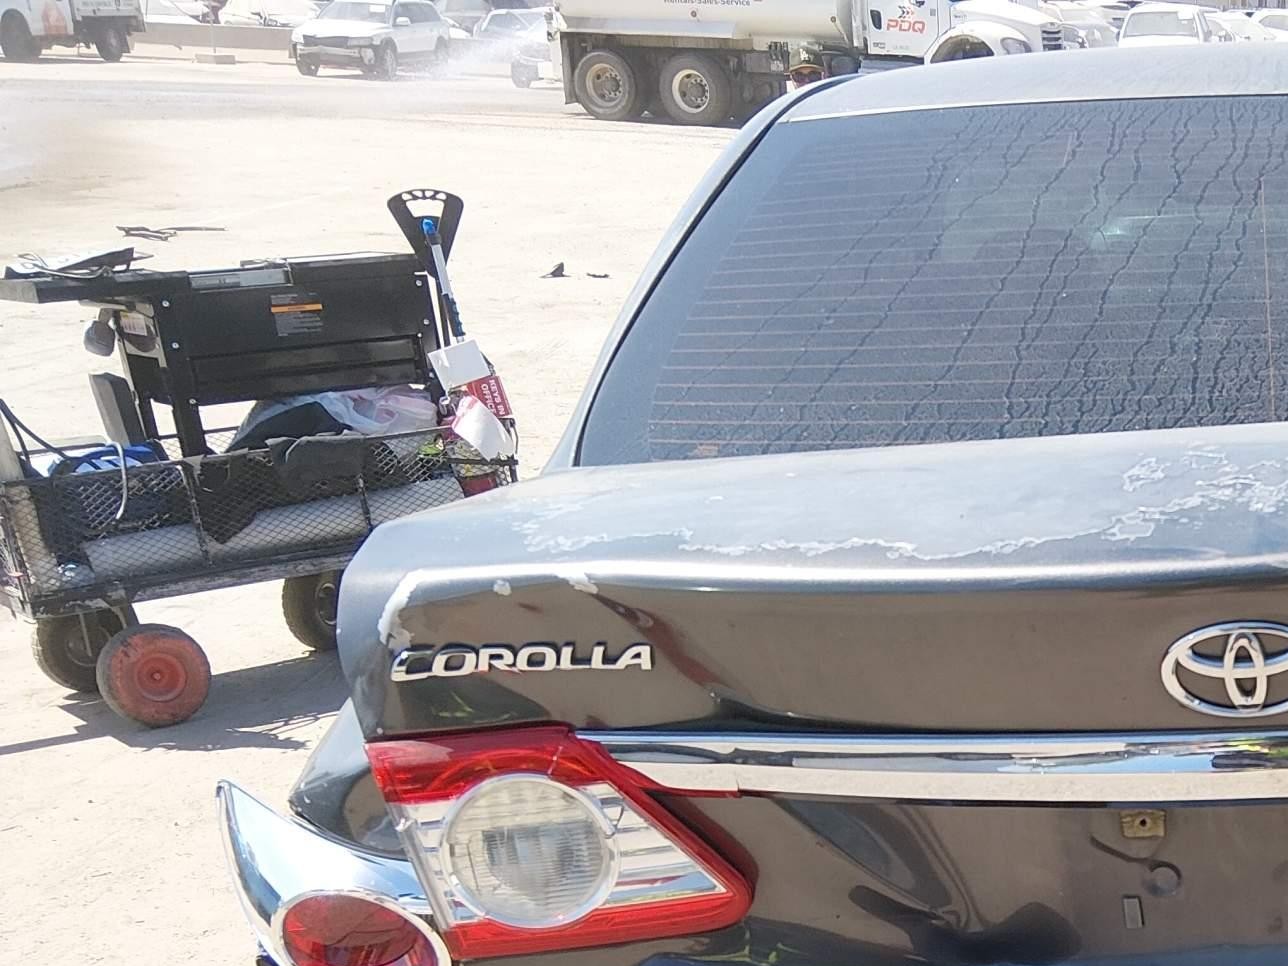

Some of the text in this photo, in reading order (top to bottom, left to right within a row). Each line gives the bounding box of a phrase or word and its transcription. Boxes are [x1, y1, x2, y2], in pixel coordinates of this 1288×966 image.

[886, 19, 926, 34] PDQ
[488, 379, 506, 416] KEYS IN
[391, 643, 652, 682] COROLLA
